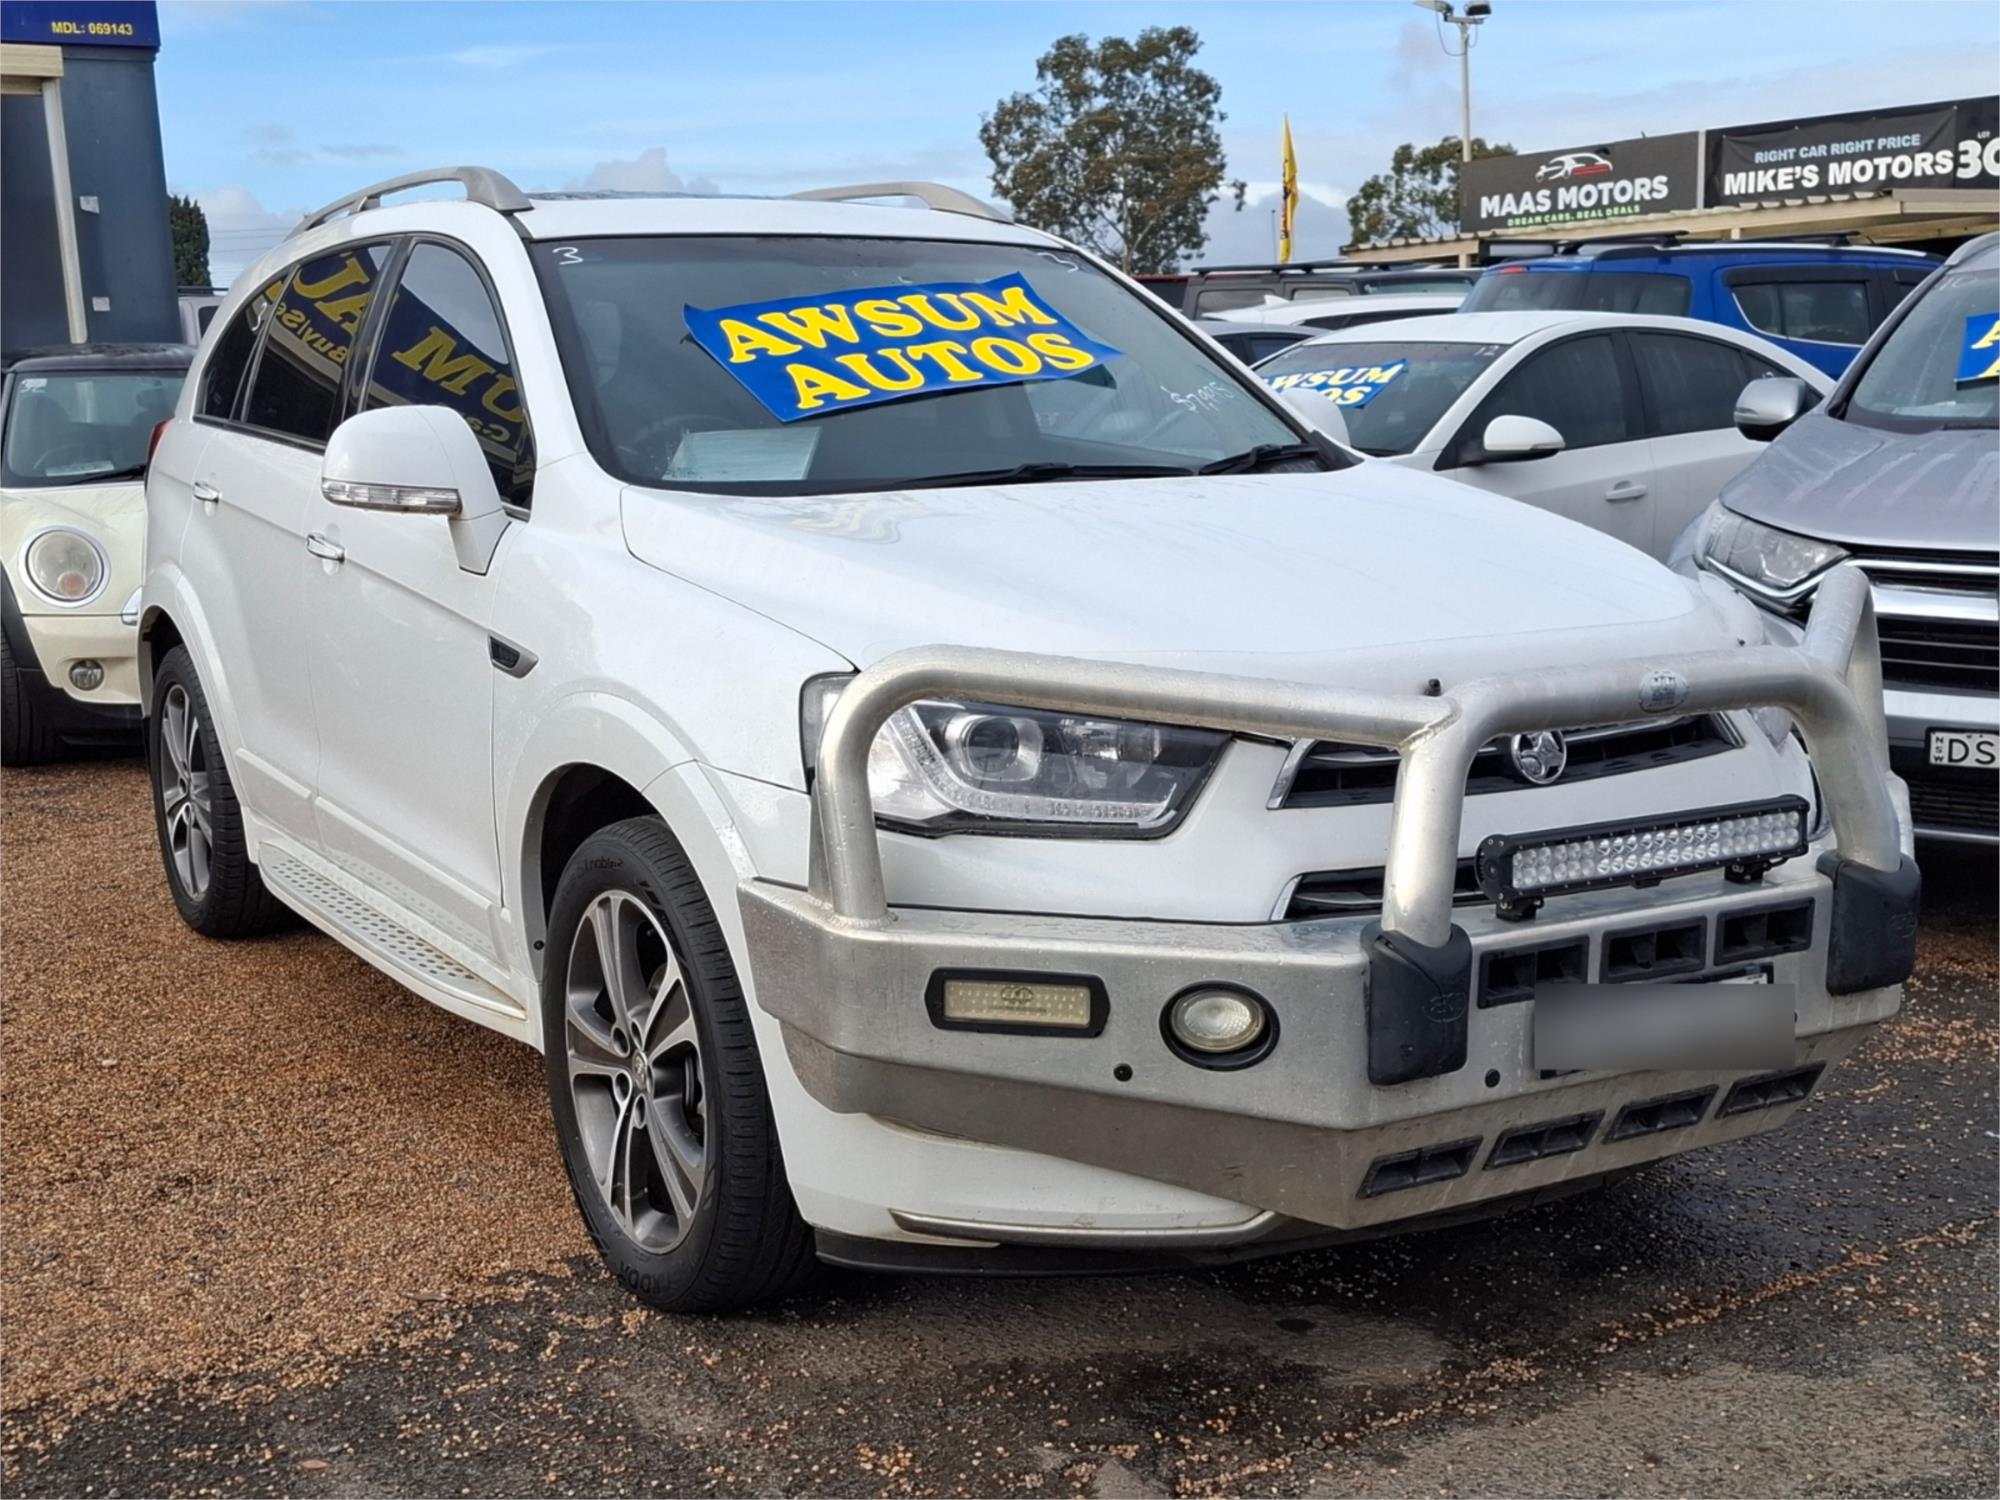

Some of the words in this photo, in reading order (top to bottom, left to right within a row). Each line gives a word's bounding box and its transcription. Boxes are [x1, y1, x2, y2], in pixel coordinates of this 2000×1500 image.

[51, 21, 86, 35] MDL:
[88, 22, 134, 36] 069143
[1754, 148, 1796, 164] RIGHT
[1799, 143, 1828, 159] CAR
[1830, 140, 1875, 157] RIGHT
[1877, 134, 1921, 150] PRICE
[1724, 164, 1820, 195] MIKE'S
[1827, 150, 1955, 186] MOTORS
[1480, 189, 1552, 219] MAAS
[1557, 175, 1669, 210] MOTORS
[1507, 215, 1542, 227] DREAM
[1577, 209, 1604, 220] REAL
[1606, 204, 1640, 216] DEALS
[551, 246, 584, 266] 3
[718, 285, 1058, 364] AWSUM
[785, 332, 1100, 410] AUTOS
[1264, 363, 1405, 390] WSUM
[1947, 738, 1997, 765] DS
